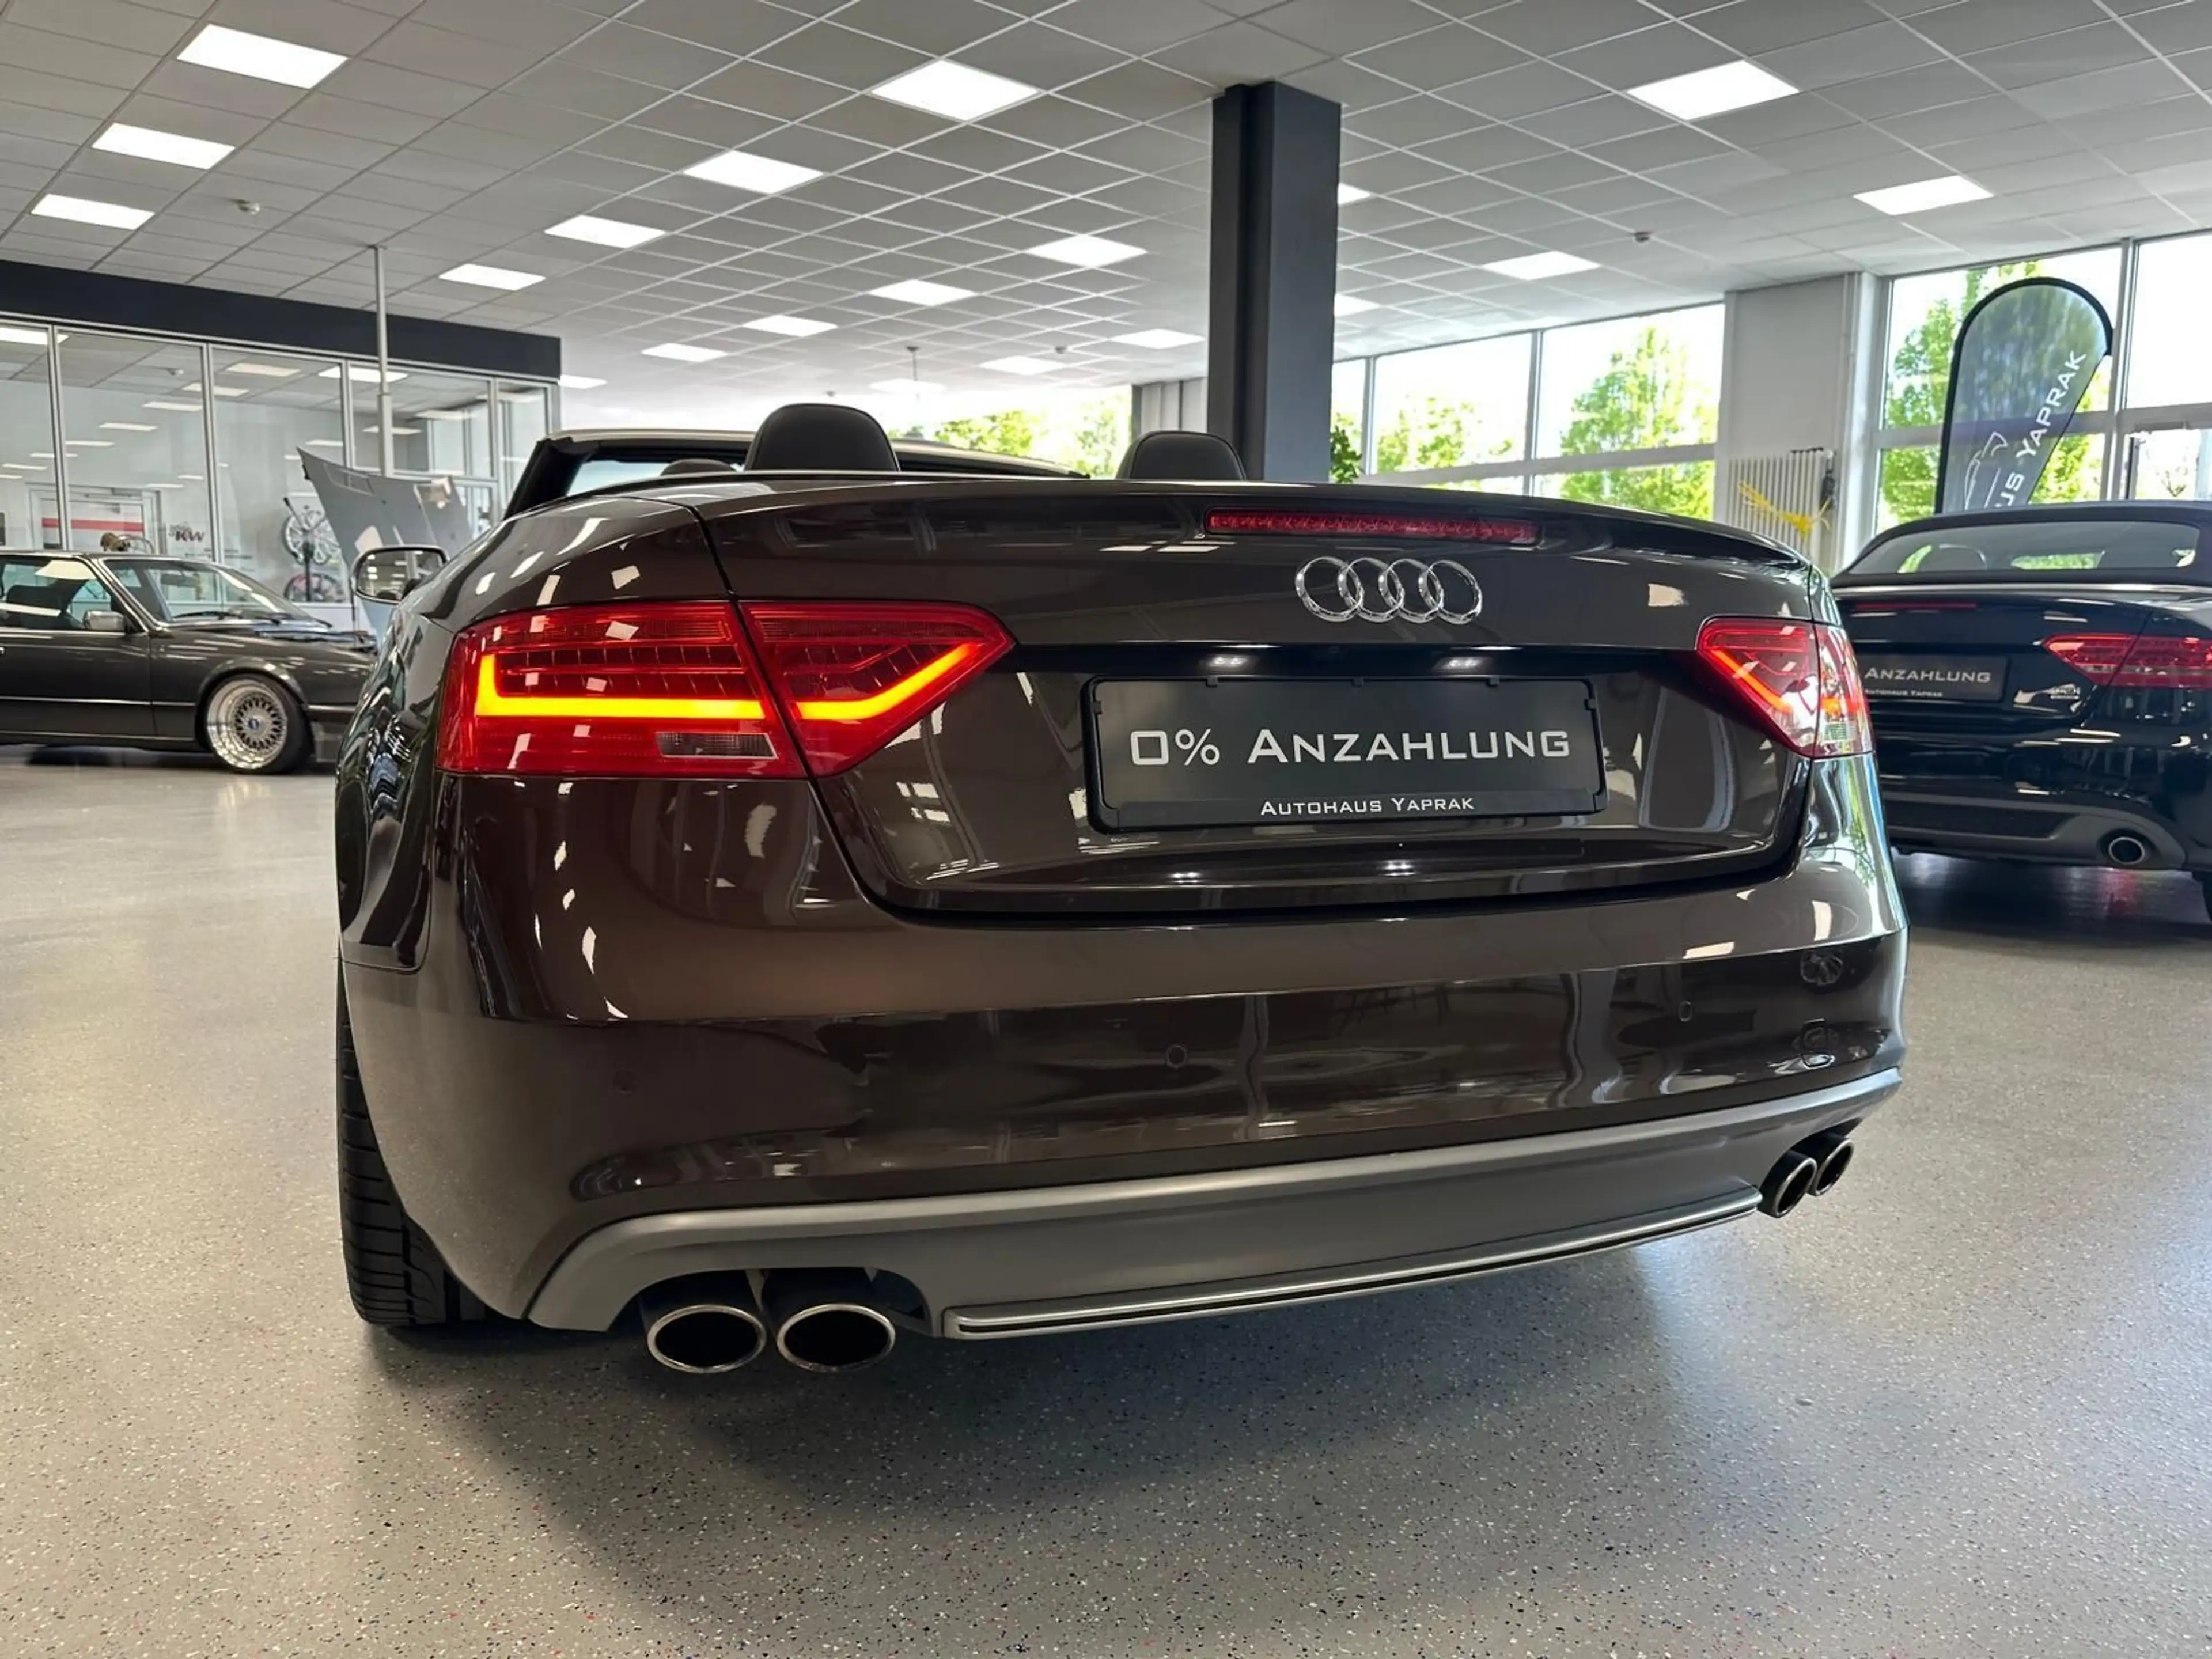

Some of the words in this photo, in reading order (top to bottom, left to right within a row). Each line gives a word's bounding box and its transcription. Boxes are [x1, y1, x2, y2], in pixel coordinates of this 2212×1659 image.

[2016, 350, 2086, 457] YAPRAK
[1865, 667, 1991, 683] ANZAHLUNG
[1130, 728, 1221, 767] 0%
[1247, 729, 1569, 764] ANZAHLUNG
[1260, 799, 1382, 816] AUTOHAUS
[1391, 797, 1475, 812] YAPRAK
